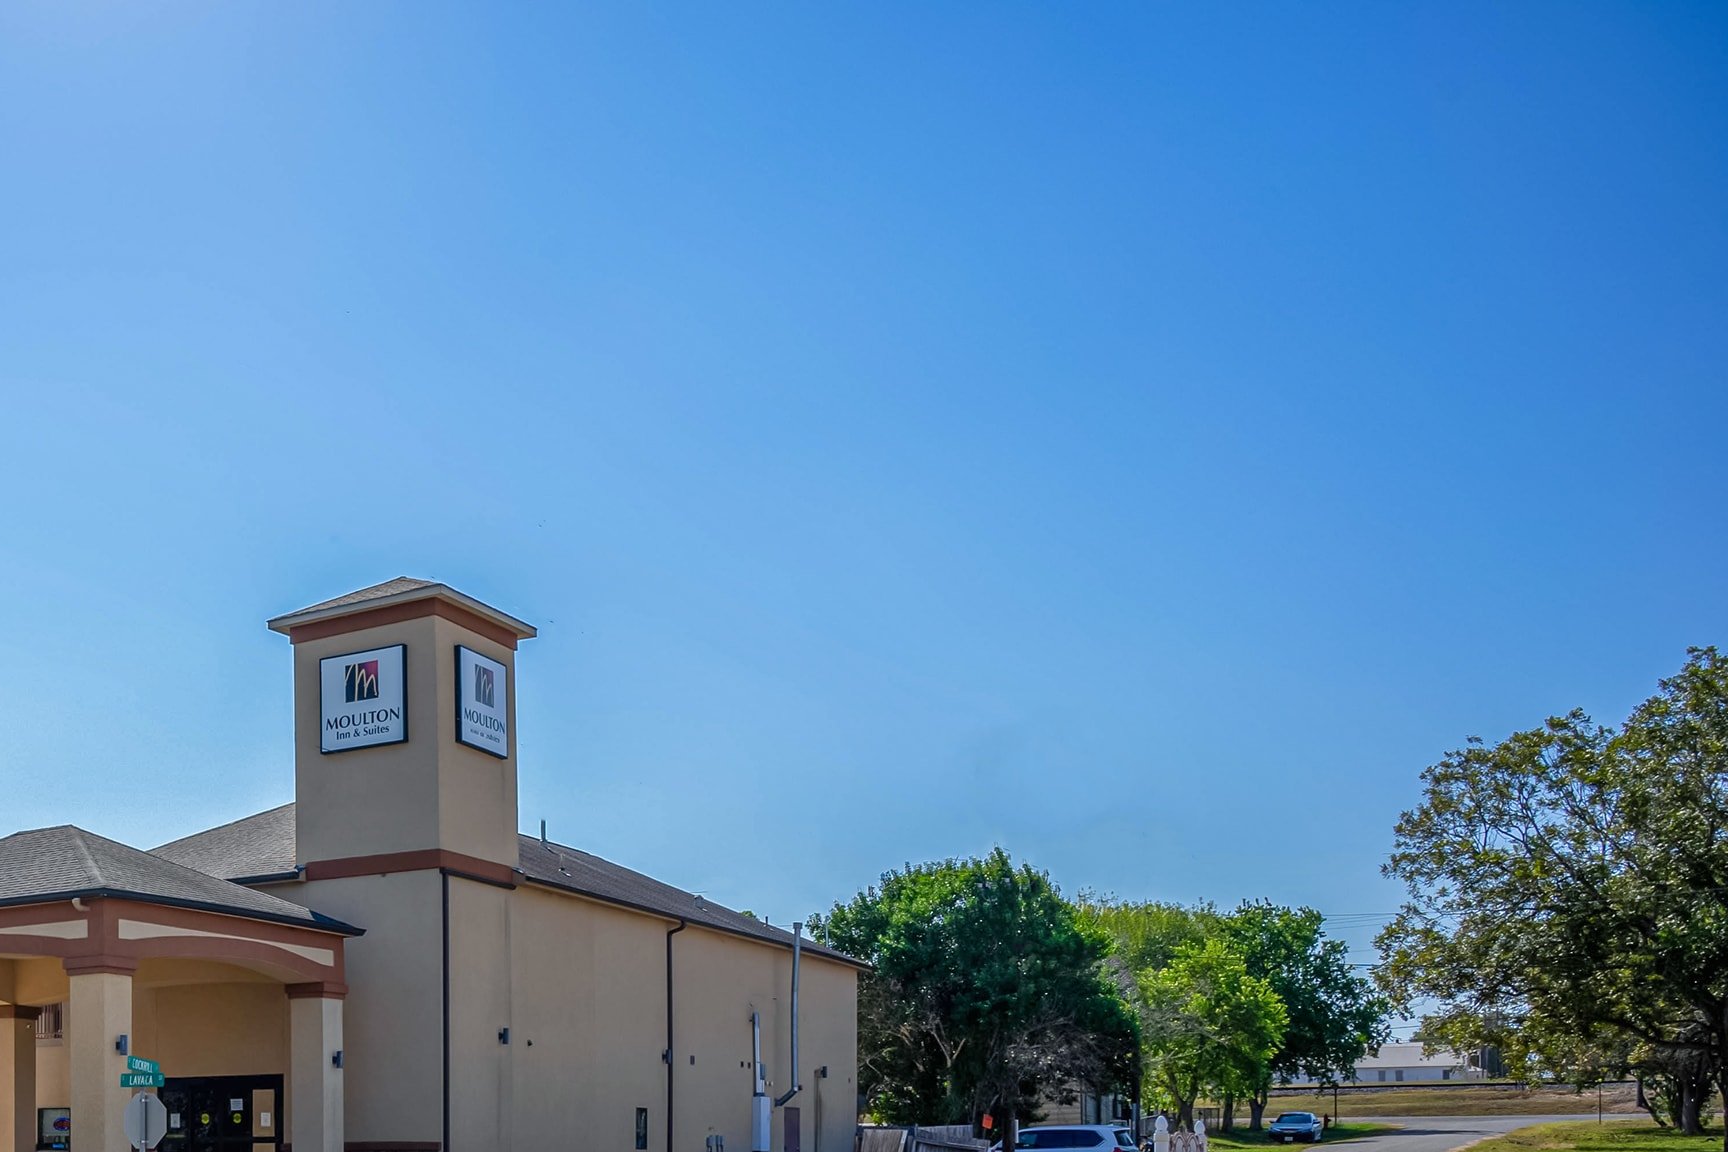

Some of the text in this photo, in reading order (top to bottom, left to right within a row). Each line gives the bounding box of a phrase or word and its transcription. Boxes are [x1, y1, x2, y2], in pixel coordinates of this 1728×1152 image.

[326, 707, 400, 731] MOULTON
[464, 707, 506, 735] MOULTON
[336, 724, 390, 741] Inn & Suites
[129, 1075, 154, 1085] LAVACA
